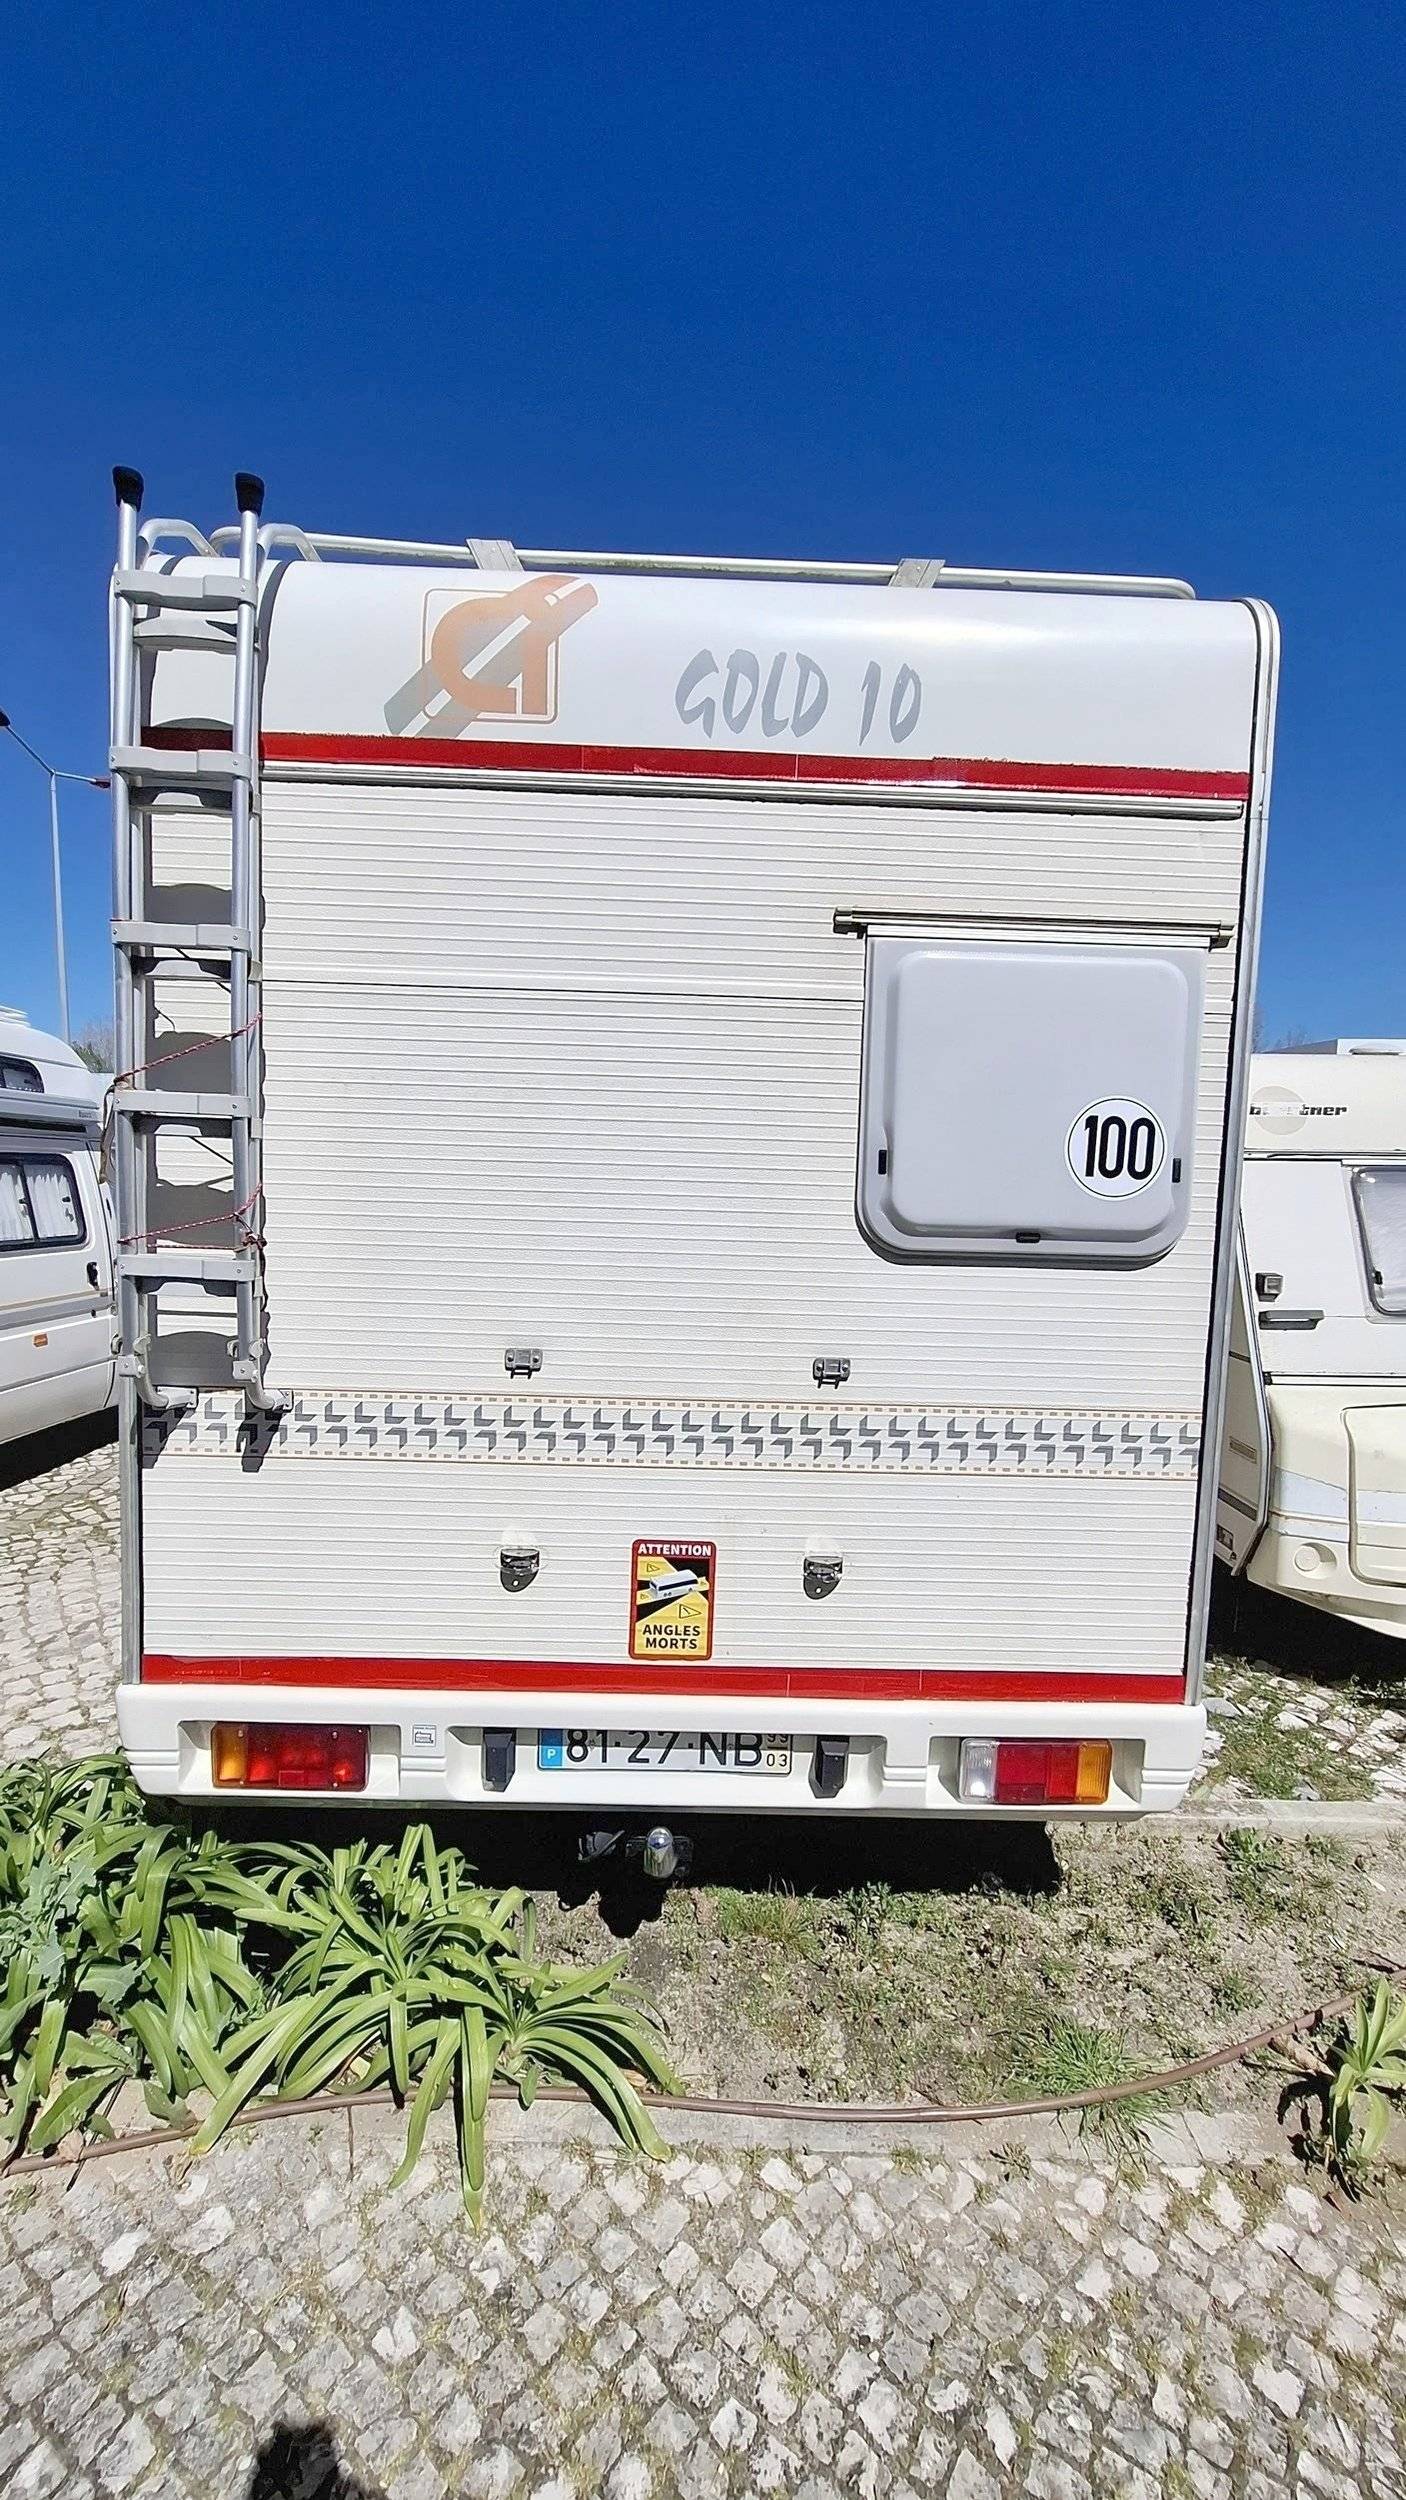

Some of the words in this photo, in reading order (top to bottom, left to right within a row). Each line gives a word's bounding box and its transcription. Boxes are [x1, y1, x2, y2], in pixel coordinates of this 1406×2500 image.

[674, 647, 830, 739] GOLD
[858, 660, 923, 746] 10
[1084, 1114, 1156, 1181] 100
[637, 1543, 712, 1556] ATTENTION
[642, 1624, 701, 1637] ANGLES
[645, 1637, 698, 1650] MORTS
[547, 1748, 557, 1760] P
[766, 1753, 788, 1767] 03
